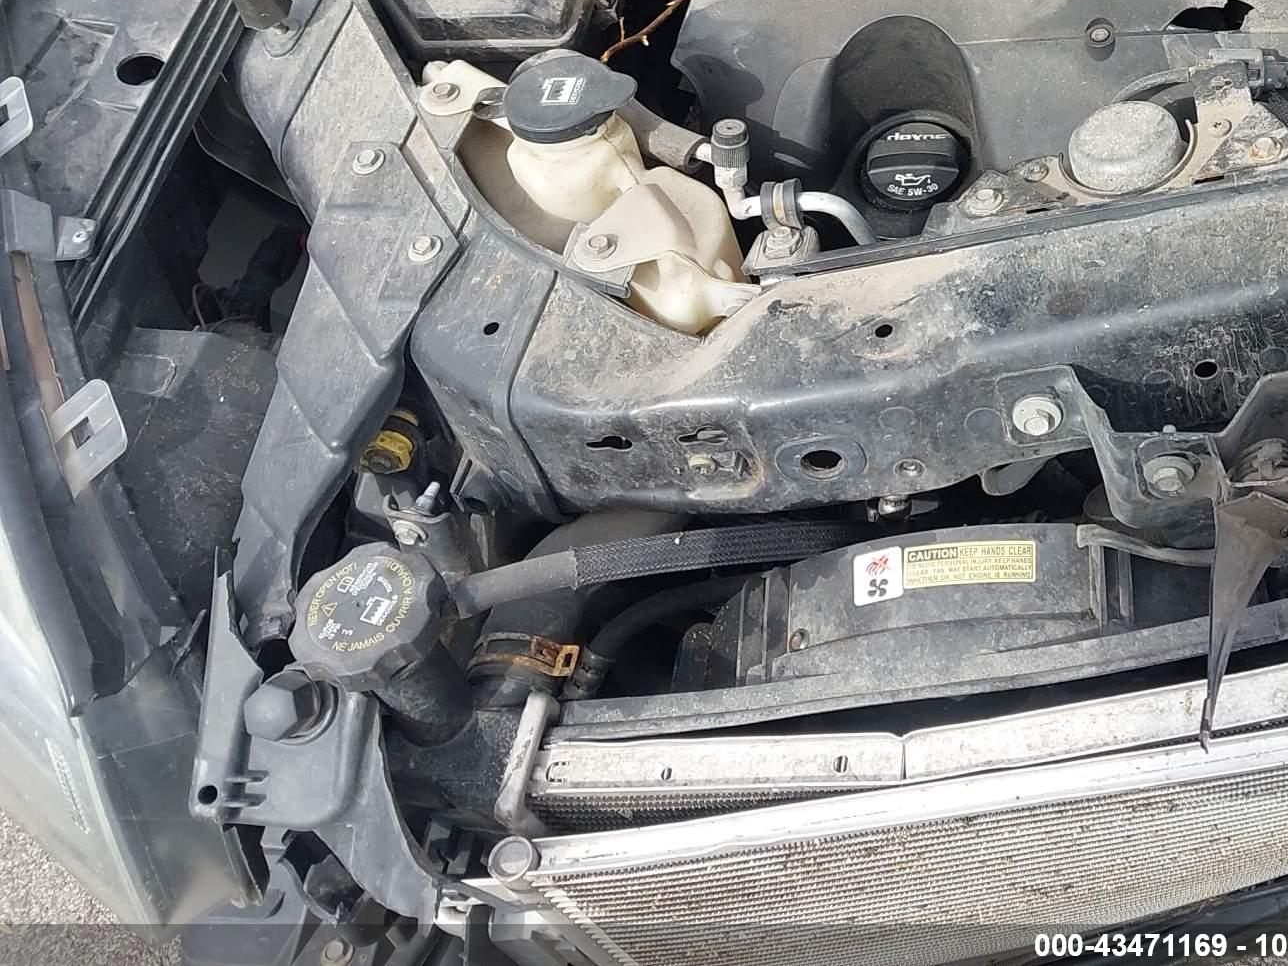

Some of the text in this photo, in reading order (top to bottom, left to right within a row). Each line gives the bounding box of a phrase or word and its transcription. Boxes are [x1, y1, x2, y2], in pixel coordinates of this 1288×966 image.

[887, 183, 938, 196] SAE 5W-30
[908, 546, 1032, 562] CAUTION KEEP HANDS CLEAR
[983, 564, 1032, 572] AUTOMATICALLY
[316, 575, 337, 598] OPEN
[332, 641, 347, 652] NE
[348, 632, 385, 652] JAMAIS
[385, 595, 412, 633] OUVRIR
